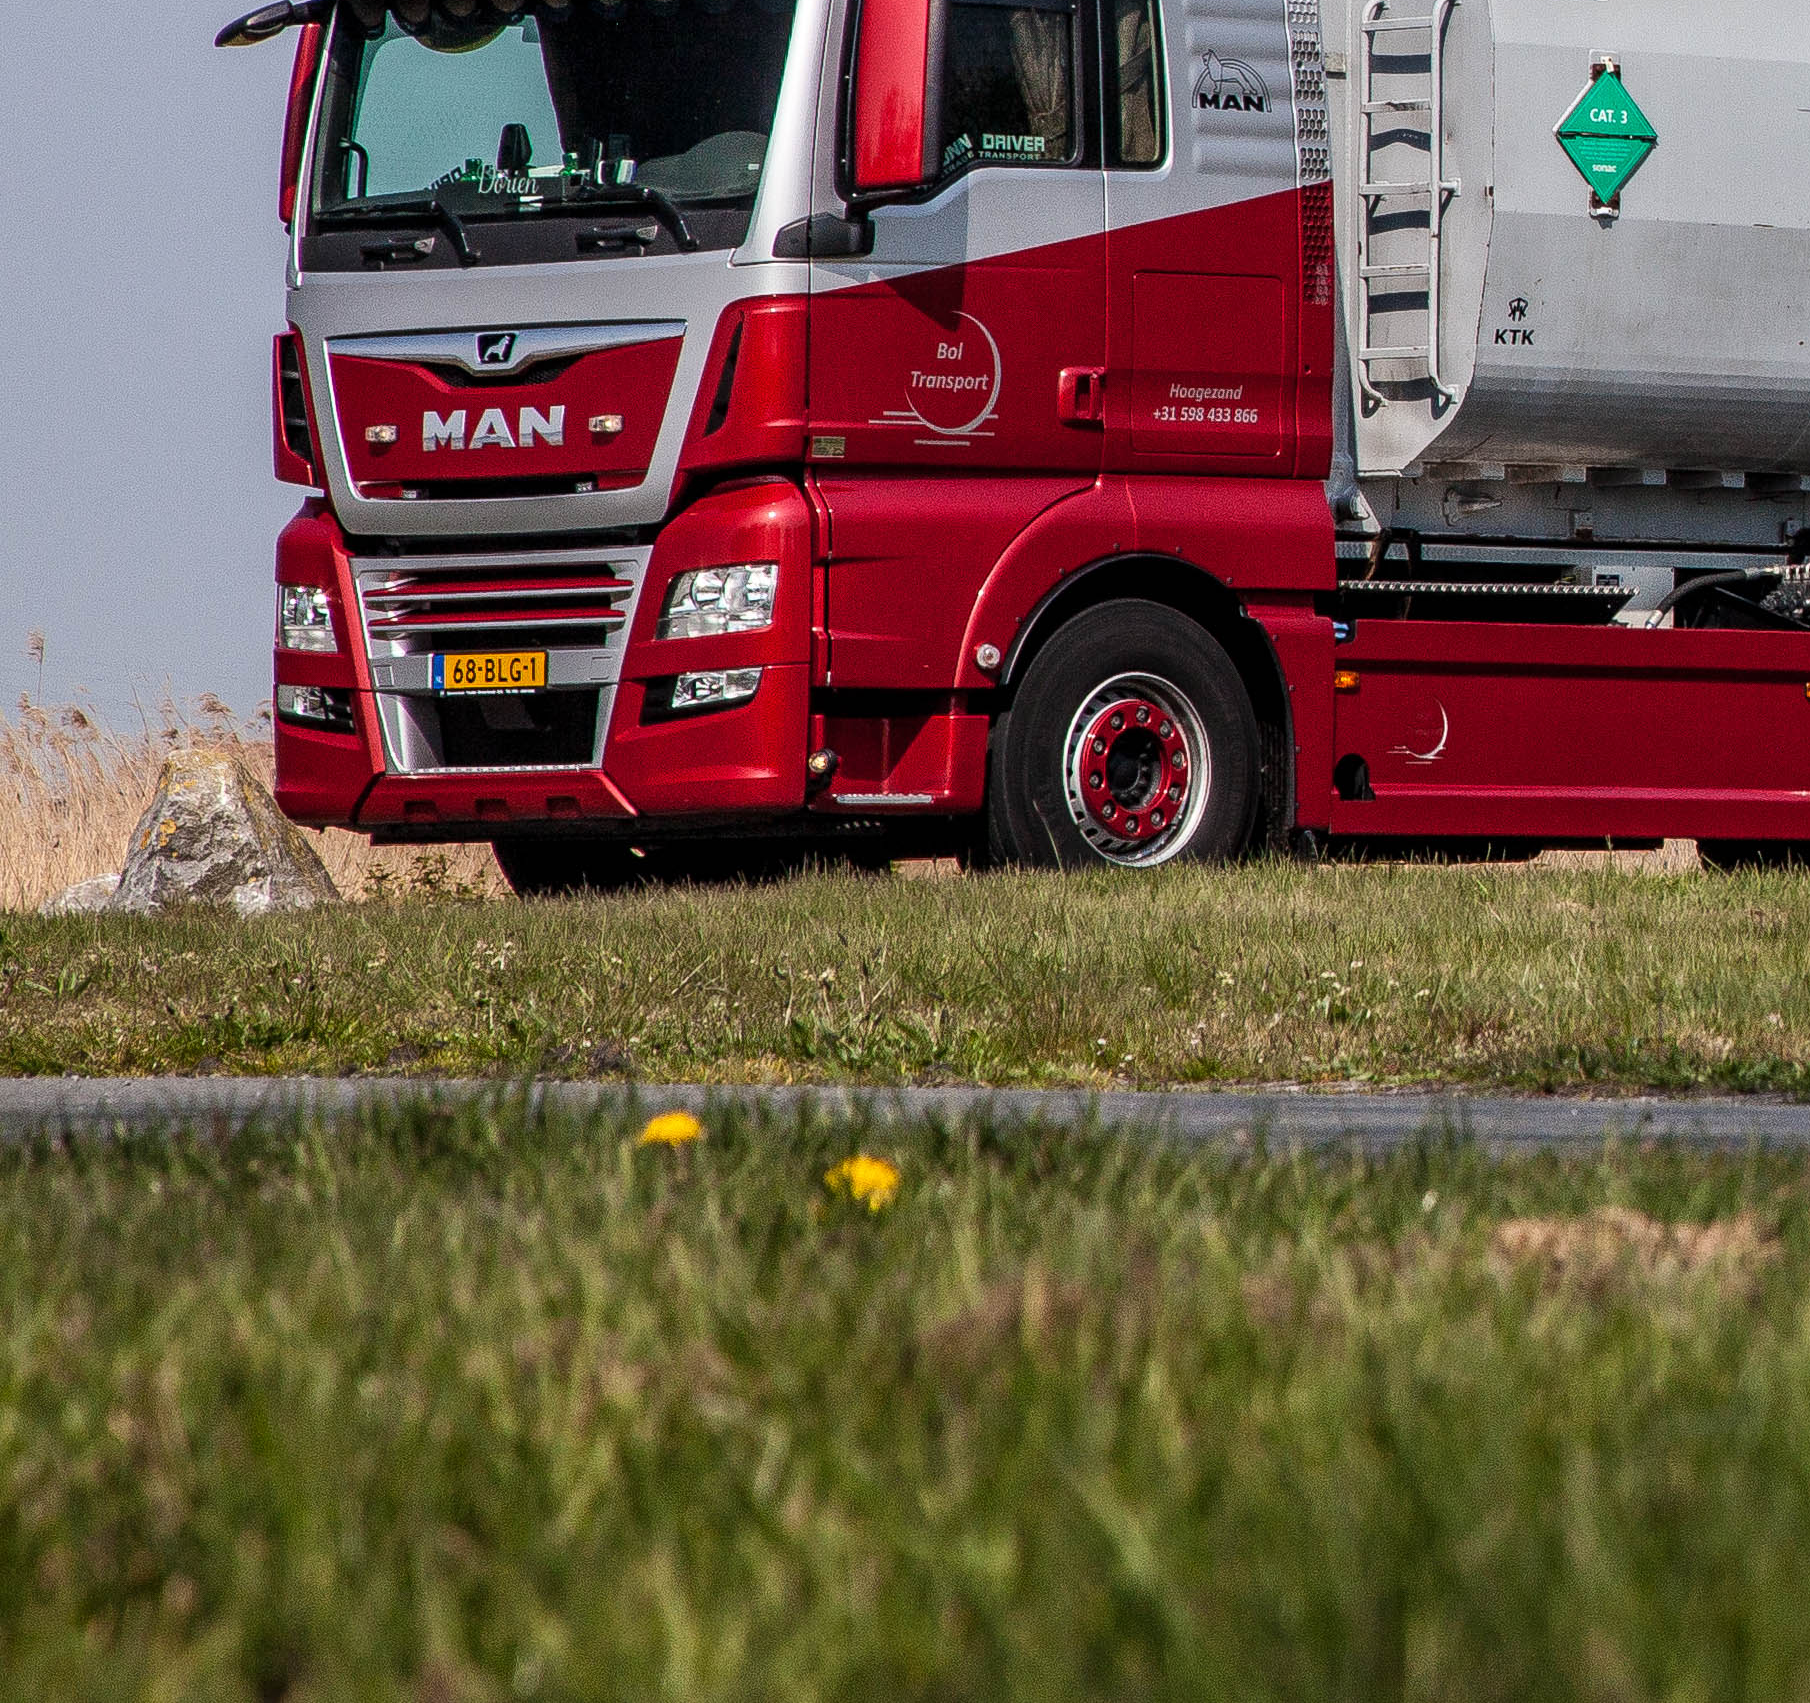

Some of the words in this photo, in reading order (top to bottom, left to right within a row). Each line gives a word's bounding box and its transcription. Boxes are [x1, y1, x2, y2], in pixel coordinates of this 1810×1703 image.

[1199, 92, 1265, 113] MAN
[1590, 108, 1617, 123] CAT.
[1620, 110, 1628, 125] 3
[982, 133, 1045, 152] DRIVER
[1494, 328, 1535, 346] KTK
[937, 342, 964, 360] Bol
[910, 370, 989, 393] Transport
[1169, 383, 1243, 402] Hoogezand
[1153, 406, 1177, 421] +31
[1180, 406, 1205, 422] 598
[1207, 407, 1231, 423] 433
[1233, 408, 1258, 424] 866
[423, 404, 566, 452] MAN
[453, 657, 536, 684] 68-BLG-1
